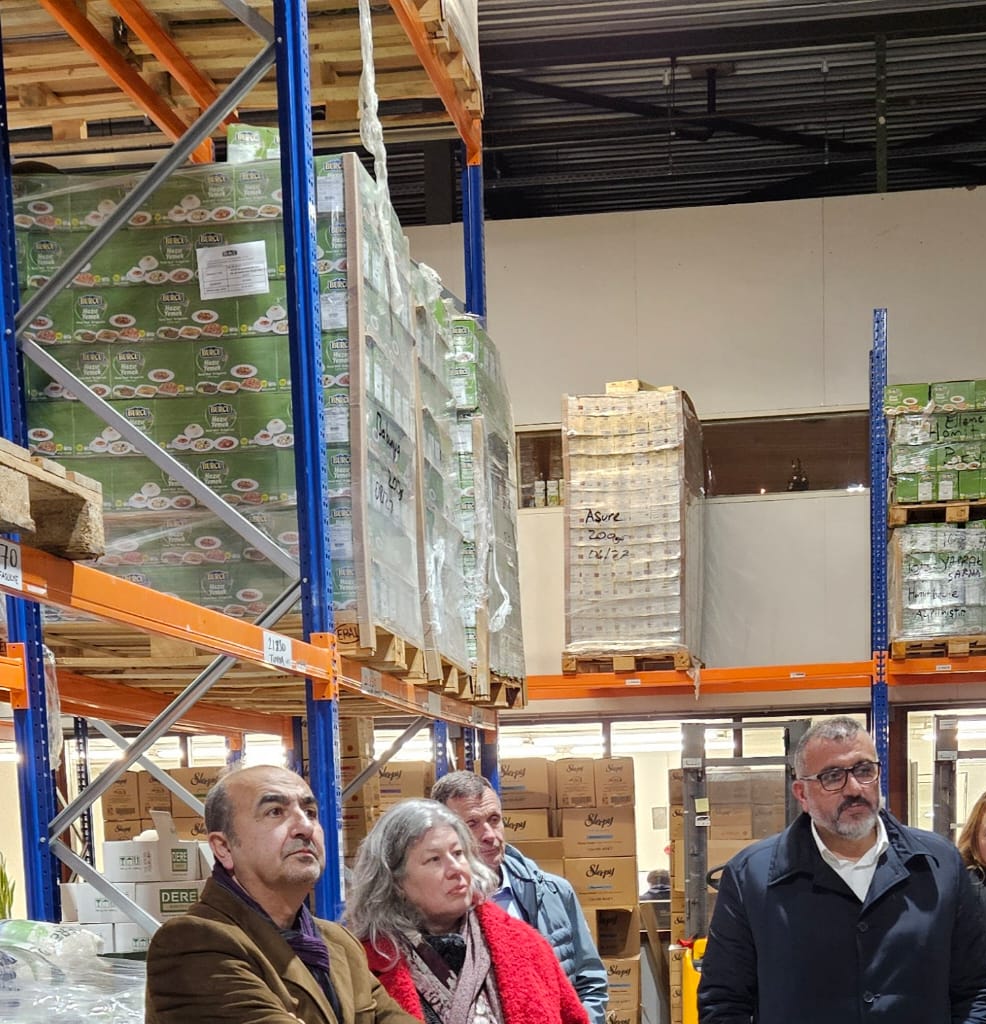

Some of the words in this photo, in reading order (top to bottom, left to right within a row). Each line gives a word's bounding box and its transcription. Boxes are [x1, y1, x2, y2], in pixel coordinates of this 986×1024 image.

[585, 814, 614, 828] Sleepy
[585, 864, 616, 879] Sleepy
[161, 891, 197, 903] DERE
[606, 965, 632, 977] Sleepy
